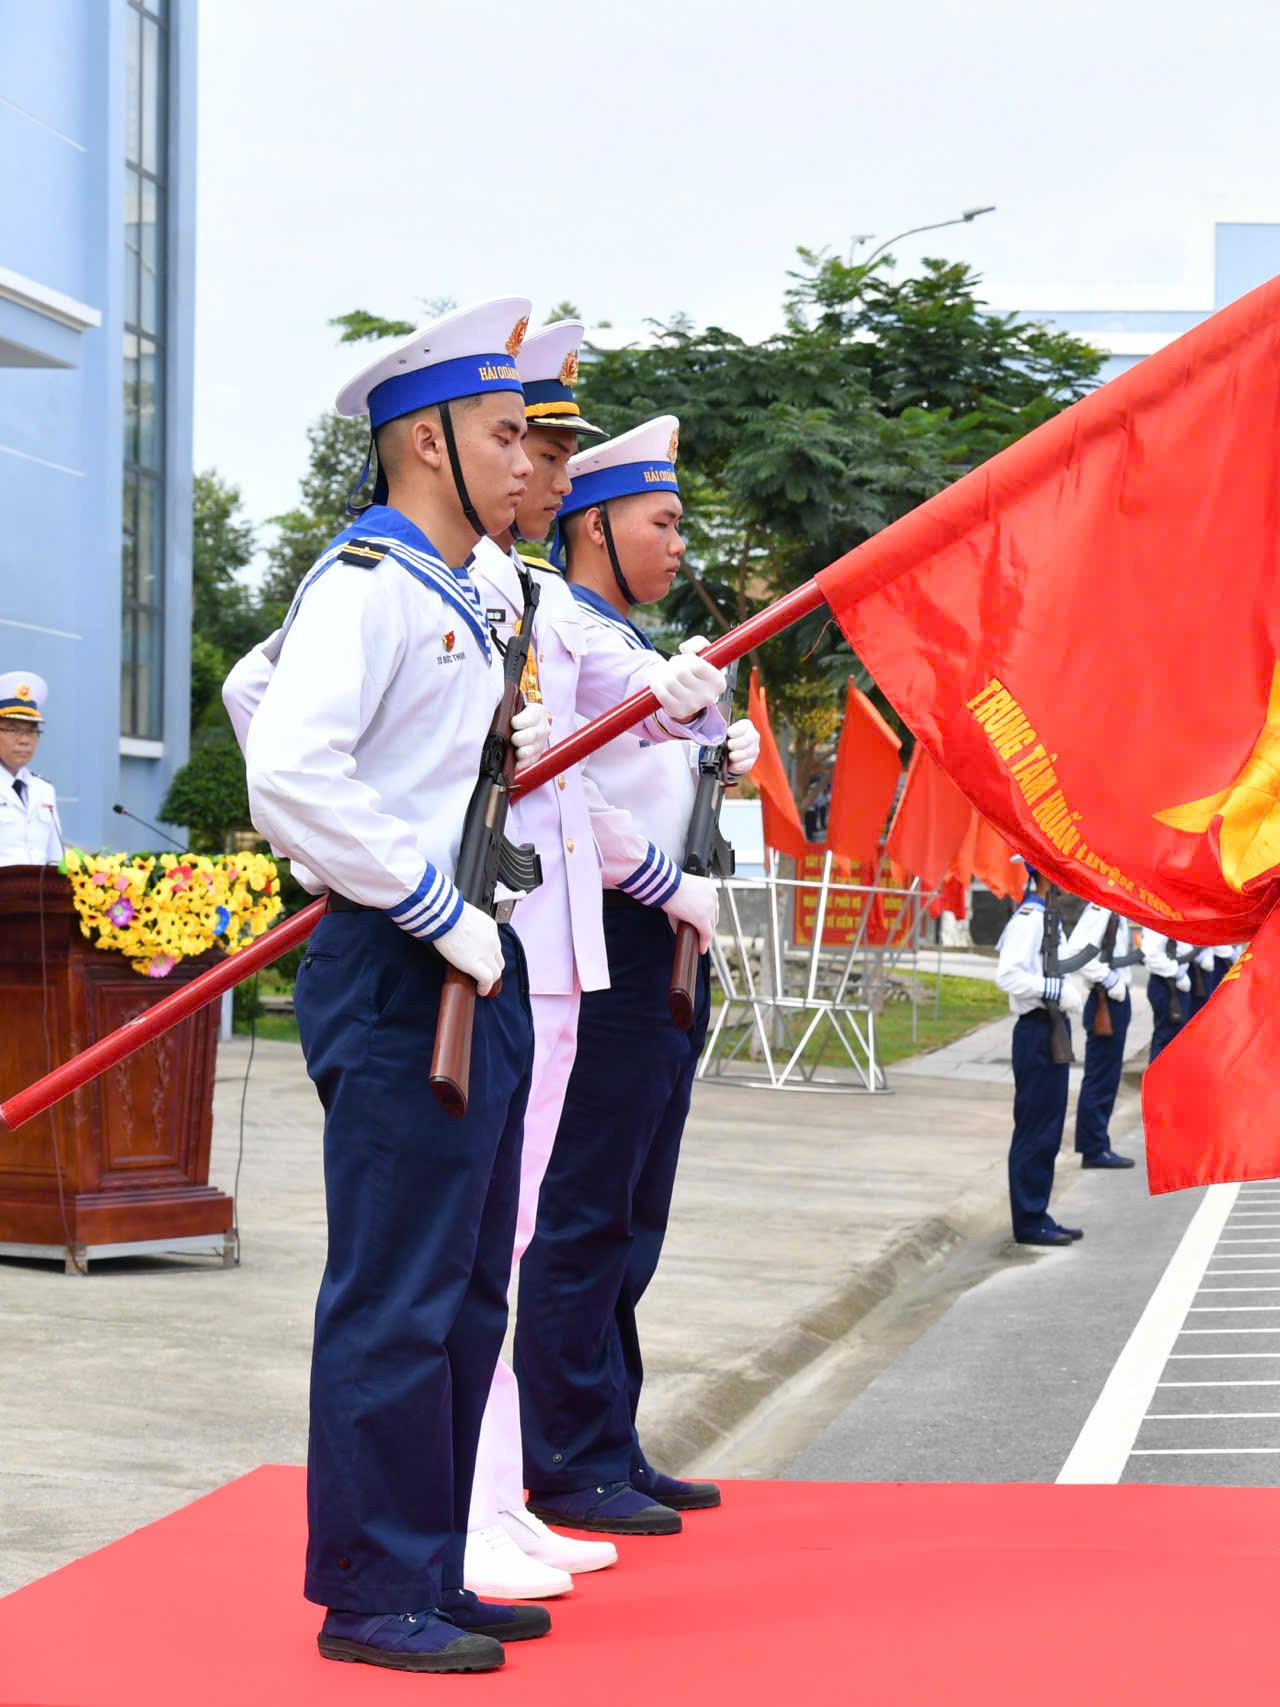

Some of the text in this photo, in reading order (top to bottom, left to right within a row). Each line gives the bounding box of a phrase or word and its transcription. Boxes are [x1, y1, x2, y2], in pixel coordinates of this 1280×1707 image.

[479, 361, 499, 381] HẢI
[643, 466, 661, 483] HẢI
[965, 677, 1037, 762] TRUNG
[1010, 743, 1058, 806] TÂM
[1031, 789, 1084, 857] HUẤN
